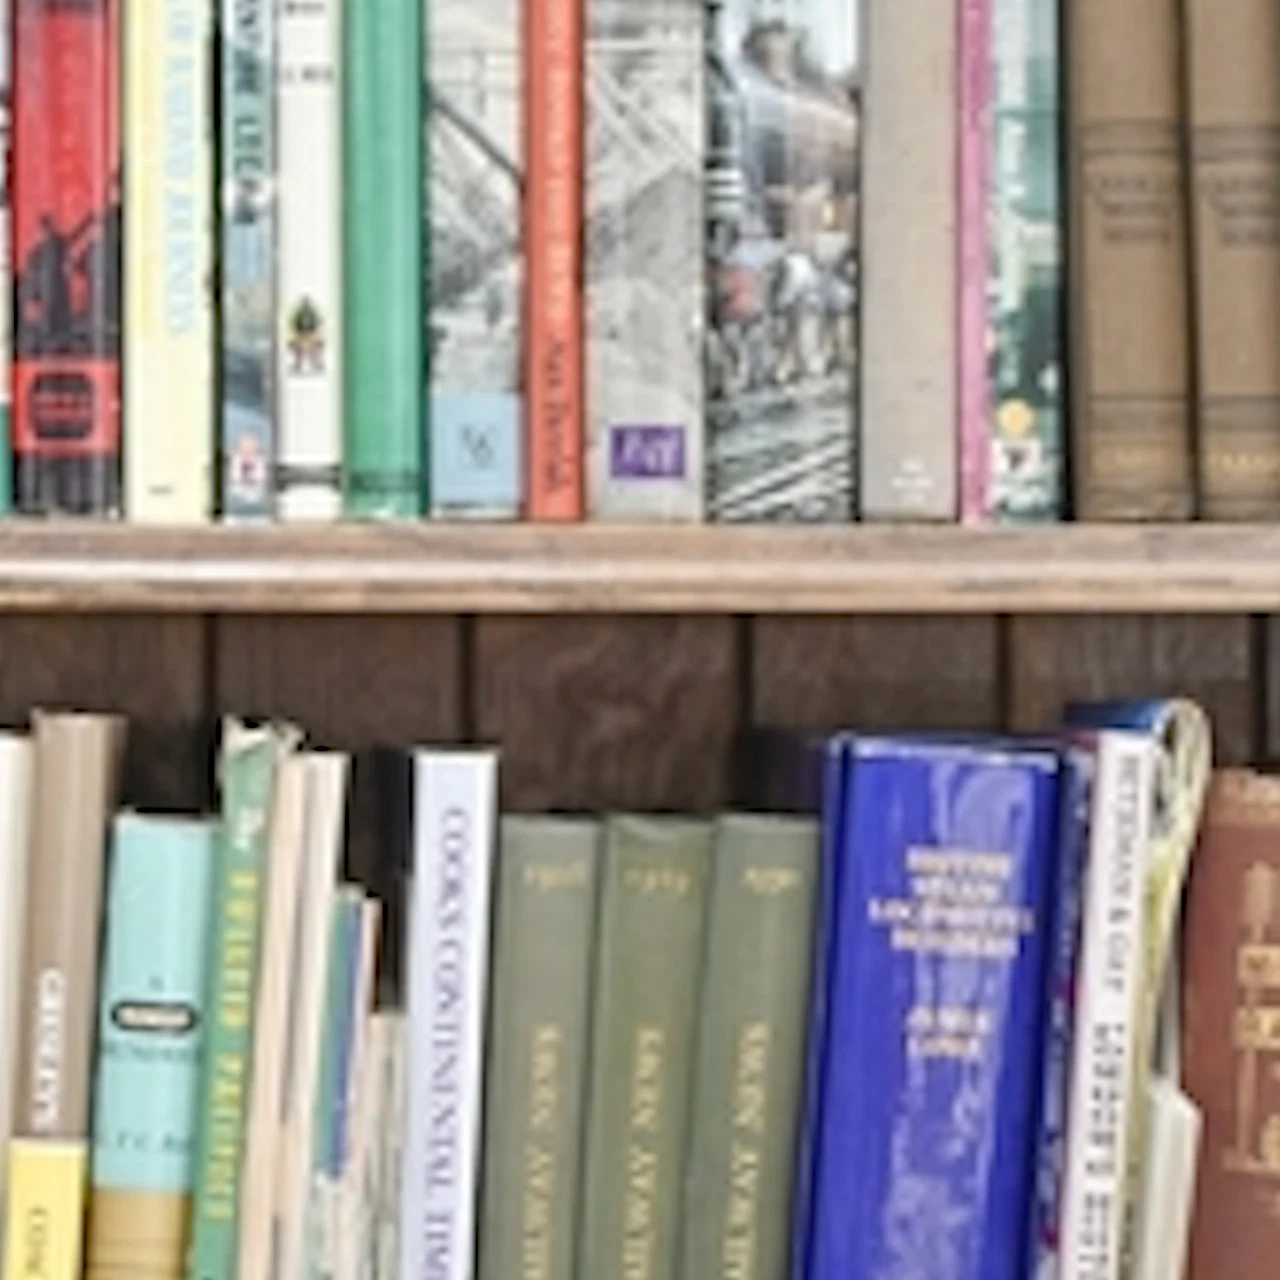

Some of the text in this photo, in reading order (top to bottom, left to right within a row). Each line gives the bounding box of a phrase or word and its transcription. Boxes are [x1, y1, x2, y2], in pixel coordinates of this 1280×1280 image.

[430, 805, 470, 933] COOKS
[422, 939, 463, 1190] CONTINENTAL
[528, 1022, 562, 1132] NEWS
[629, 1026, 664, 1133] NEWS
[730, 1022, 769, 1132] NEWS
